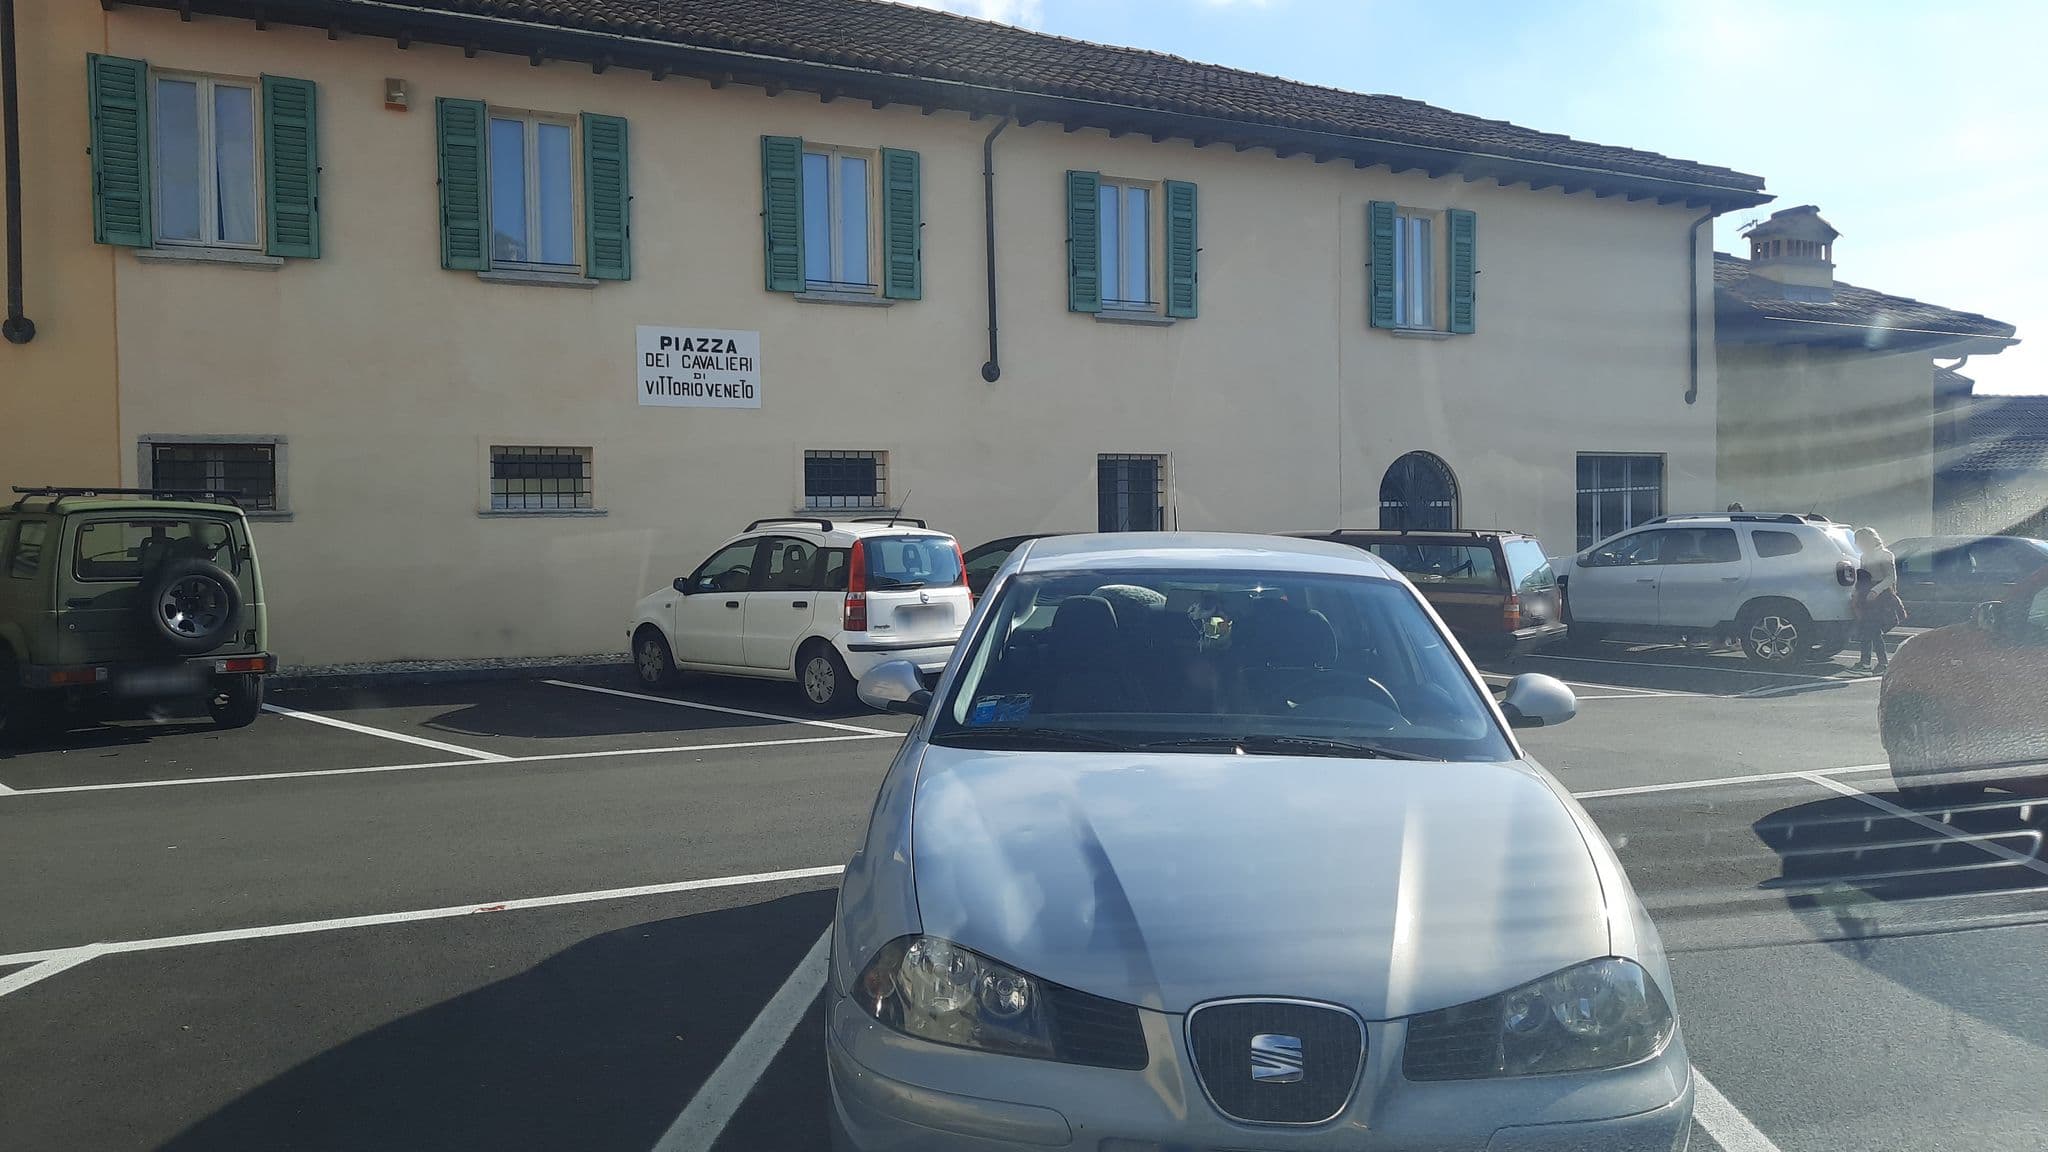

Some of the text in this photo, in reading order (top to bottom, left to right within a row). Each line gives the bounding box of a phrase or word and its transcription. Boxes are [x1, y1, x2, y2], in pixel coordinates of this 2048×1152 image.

[660, 335, 737, 354] PIAZZA
[645, 352, 752, 372] DEI CAVALIERI
[693, 372, 706, 380] DI
[645, 375, 754, 399] VITTORIO VENETO
